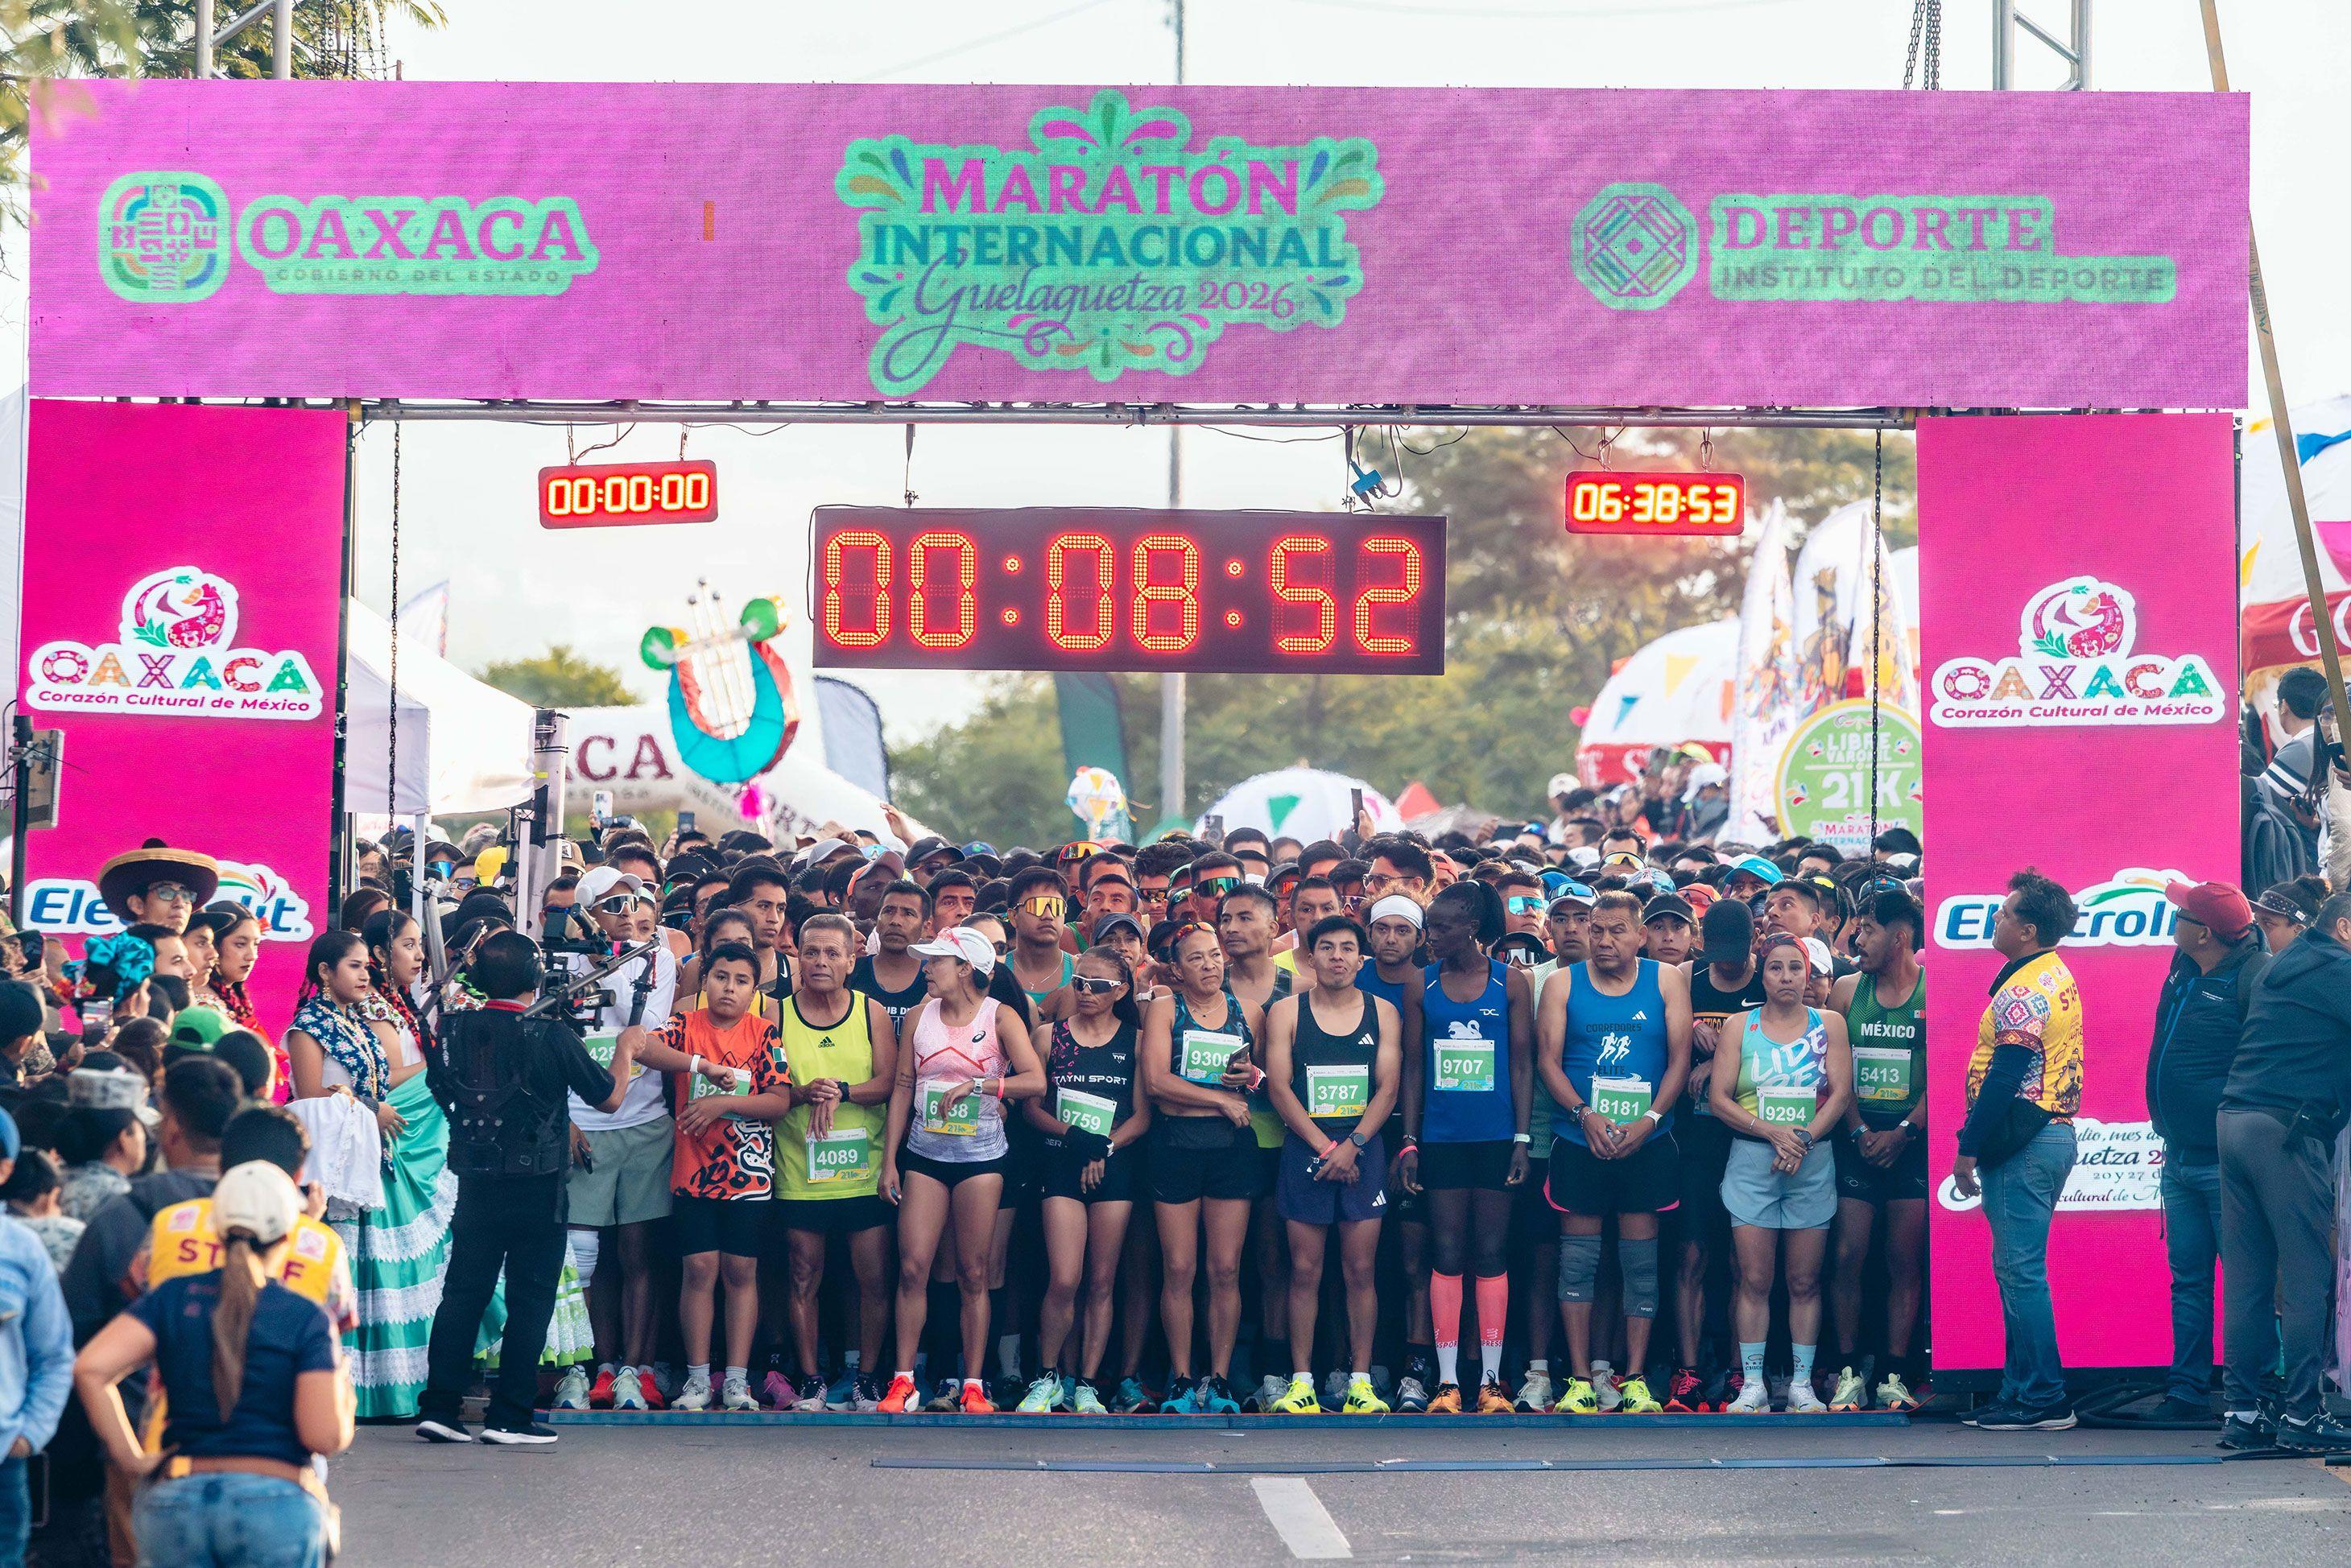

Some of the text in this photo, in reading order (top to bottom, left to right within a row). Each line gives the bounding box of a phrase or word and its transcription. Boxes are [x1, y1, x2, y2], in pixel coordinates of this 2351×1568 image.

[919, 150, 1299, 215] MARATÓN
[250, 208, 586, 261] OAXACA
[1722, 206, 2043, 251] DEPORTE
[872, 224, 1346, 268] INTERNACIONAL
[277, 269, 560, 283] GOBIERNO DEL ESTADO
[1722, 266, 2166, 291] INSTITUTO DEL DEPORTE
[882, 248, 1296, 382] Guelaguetza 2026
[547, 472, 709, 515] 00:00:00
[1573, 481, 1737, 524] 06:38:53
[824, 530, 1423, 654] 00:08:52
[42, 650, 310, 695] OAXACA
[1943, 662, 2213, 701] OAXACA
[38, 690, 310, 713] Corazón Cultural de México
[1941, 701, 2213, 719] Corazón Cultural de México
[1861, 1021, 1916, 1039] MÉXICO
[1443, 1058, 1484, 1075] 9707
[1860, 1067, 1900, 1083] 5413
[1054, 1075, 1128, 1086] TAYNI SPORT
[1317, 1084, 1359, 1101] 3787
[929, 1100, 969, 1118] 638
[1599, 1098, 1639, 1116] 8181
[1766, 1106, 1807, 1122] 9294
[1062, 1108, 1101, 1131] 9759
[816, 1149, 859, 1166] 4089
